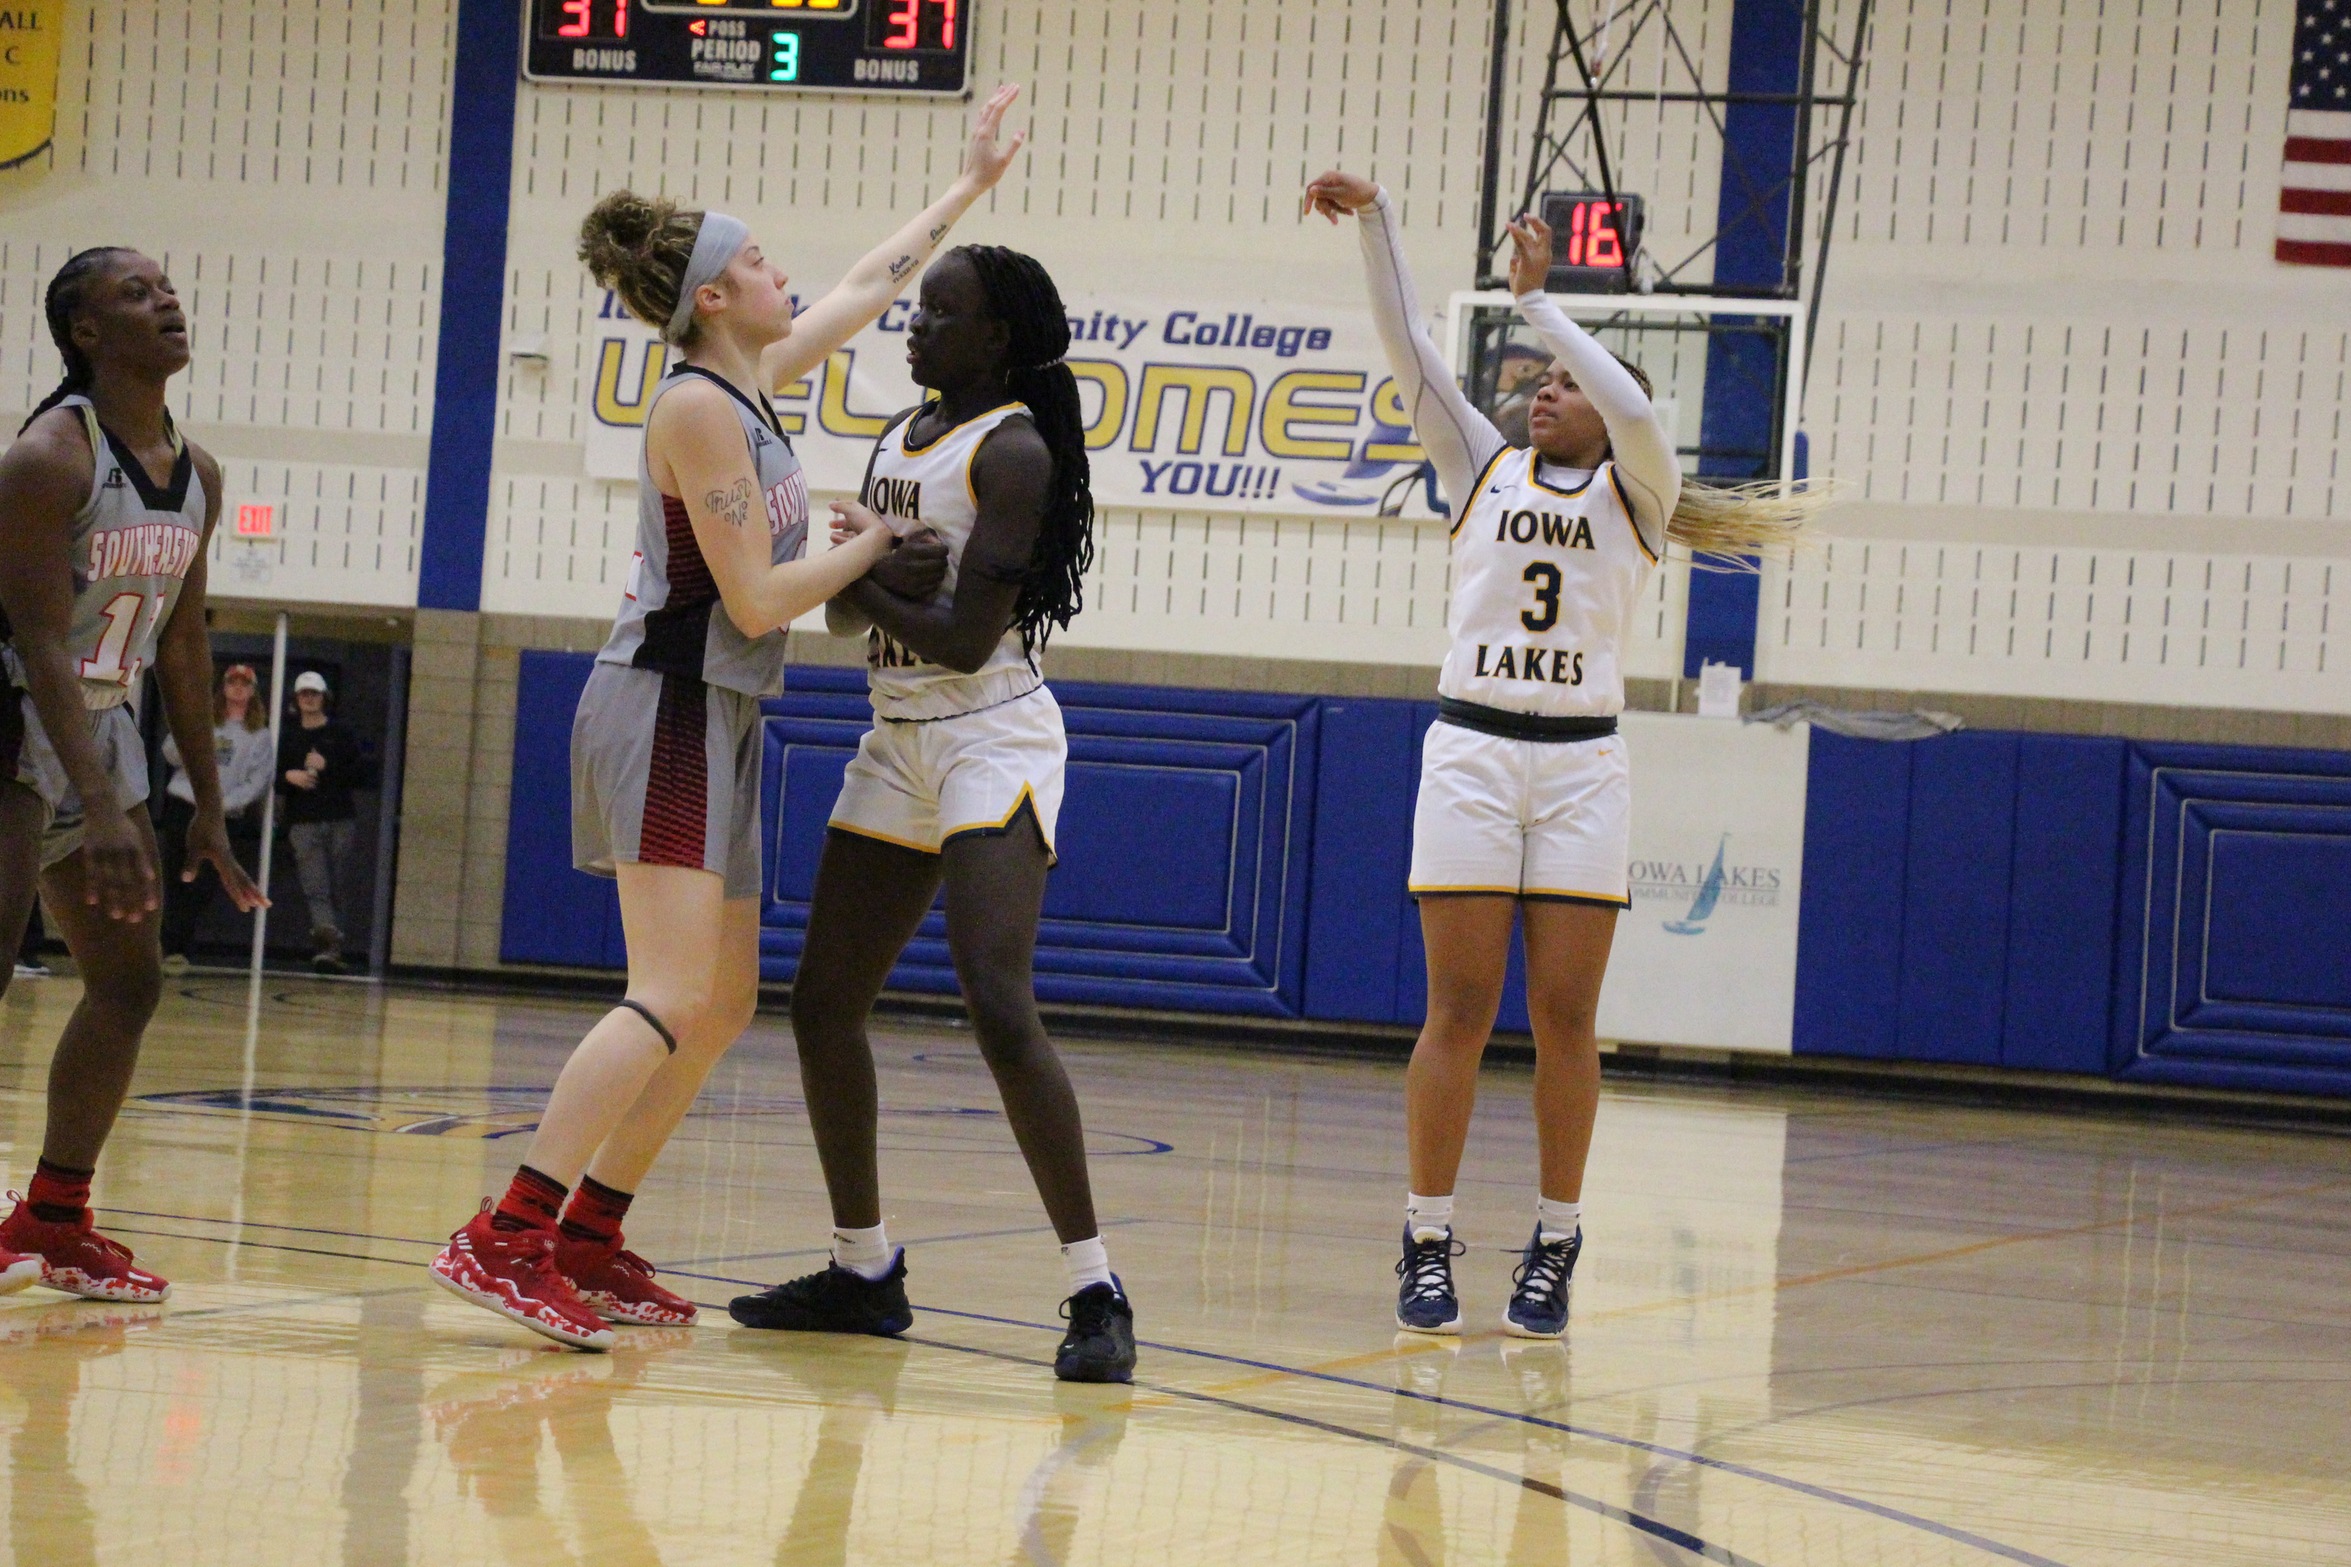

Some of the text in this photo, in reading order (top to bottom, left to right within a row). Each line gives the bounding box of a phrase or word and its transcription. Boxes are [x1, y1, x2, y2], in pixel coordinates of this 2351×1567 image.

[708, 20, 746, 38] POSS
[572, 48, 637, 72] BONUS
[691, 38, 761, 62] PERIOD
[770, 32, 799, 81] 3
[853, 58, 919, 83] BONUS
[1568, 202, 1624, 267] 16
[1163, 310, 1332, 357] College
[869, 476, 922, 520] IOWA
[1139, 459, 1281, 499] YOU!!!
[237, 504, 273, 535] EXIT
[1496, 509, 1596, 550] IOWA
[1520, 559, 1563, 634] 3
[1474, 644, 1584, 687] LAKES
[1628, 860, 1687, 883] OWA
